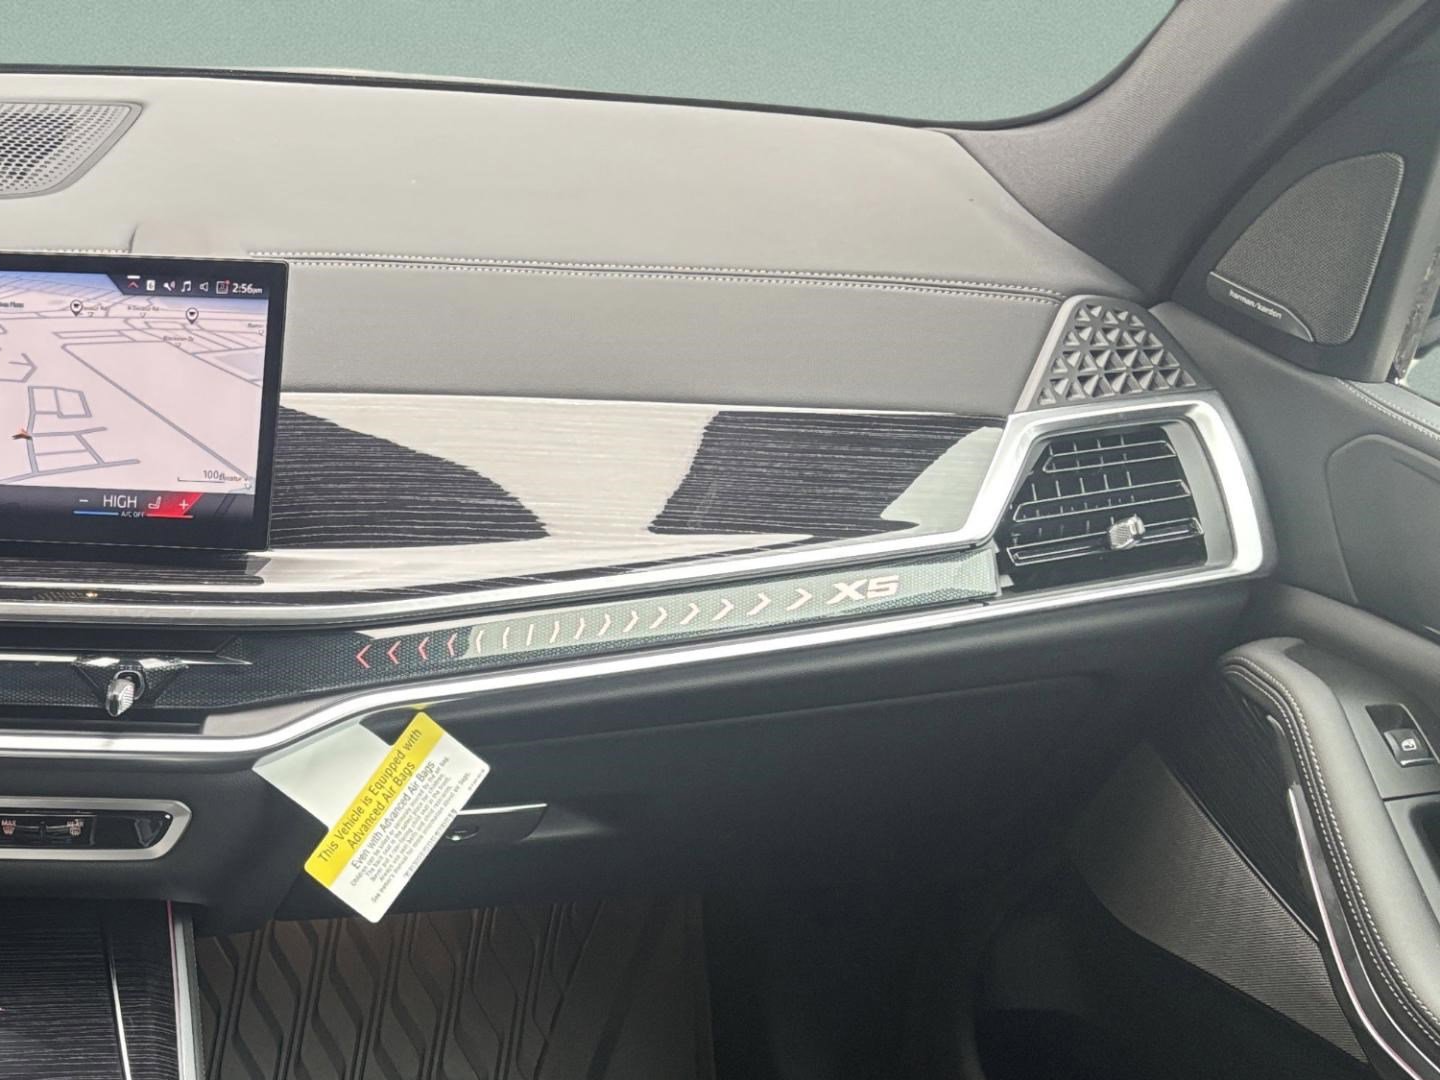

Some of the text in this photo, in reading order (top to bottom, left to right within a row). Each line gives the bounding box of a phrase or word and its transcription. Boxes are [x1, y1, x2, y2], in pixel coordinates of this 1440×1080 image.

[103, 495, 137, 508] HIGH
[826, 575, 900, 605] X5
[317, 727, 422, 863] This Vehicle is Equipped with
[344, 759, 418, 849] Advanced Air Bags
[349, 758, 437, 870] Even with Advanced Air Bags
